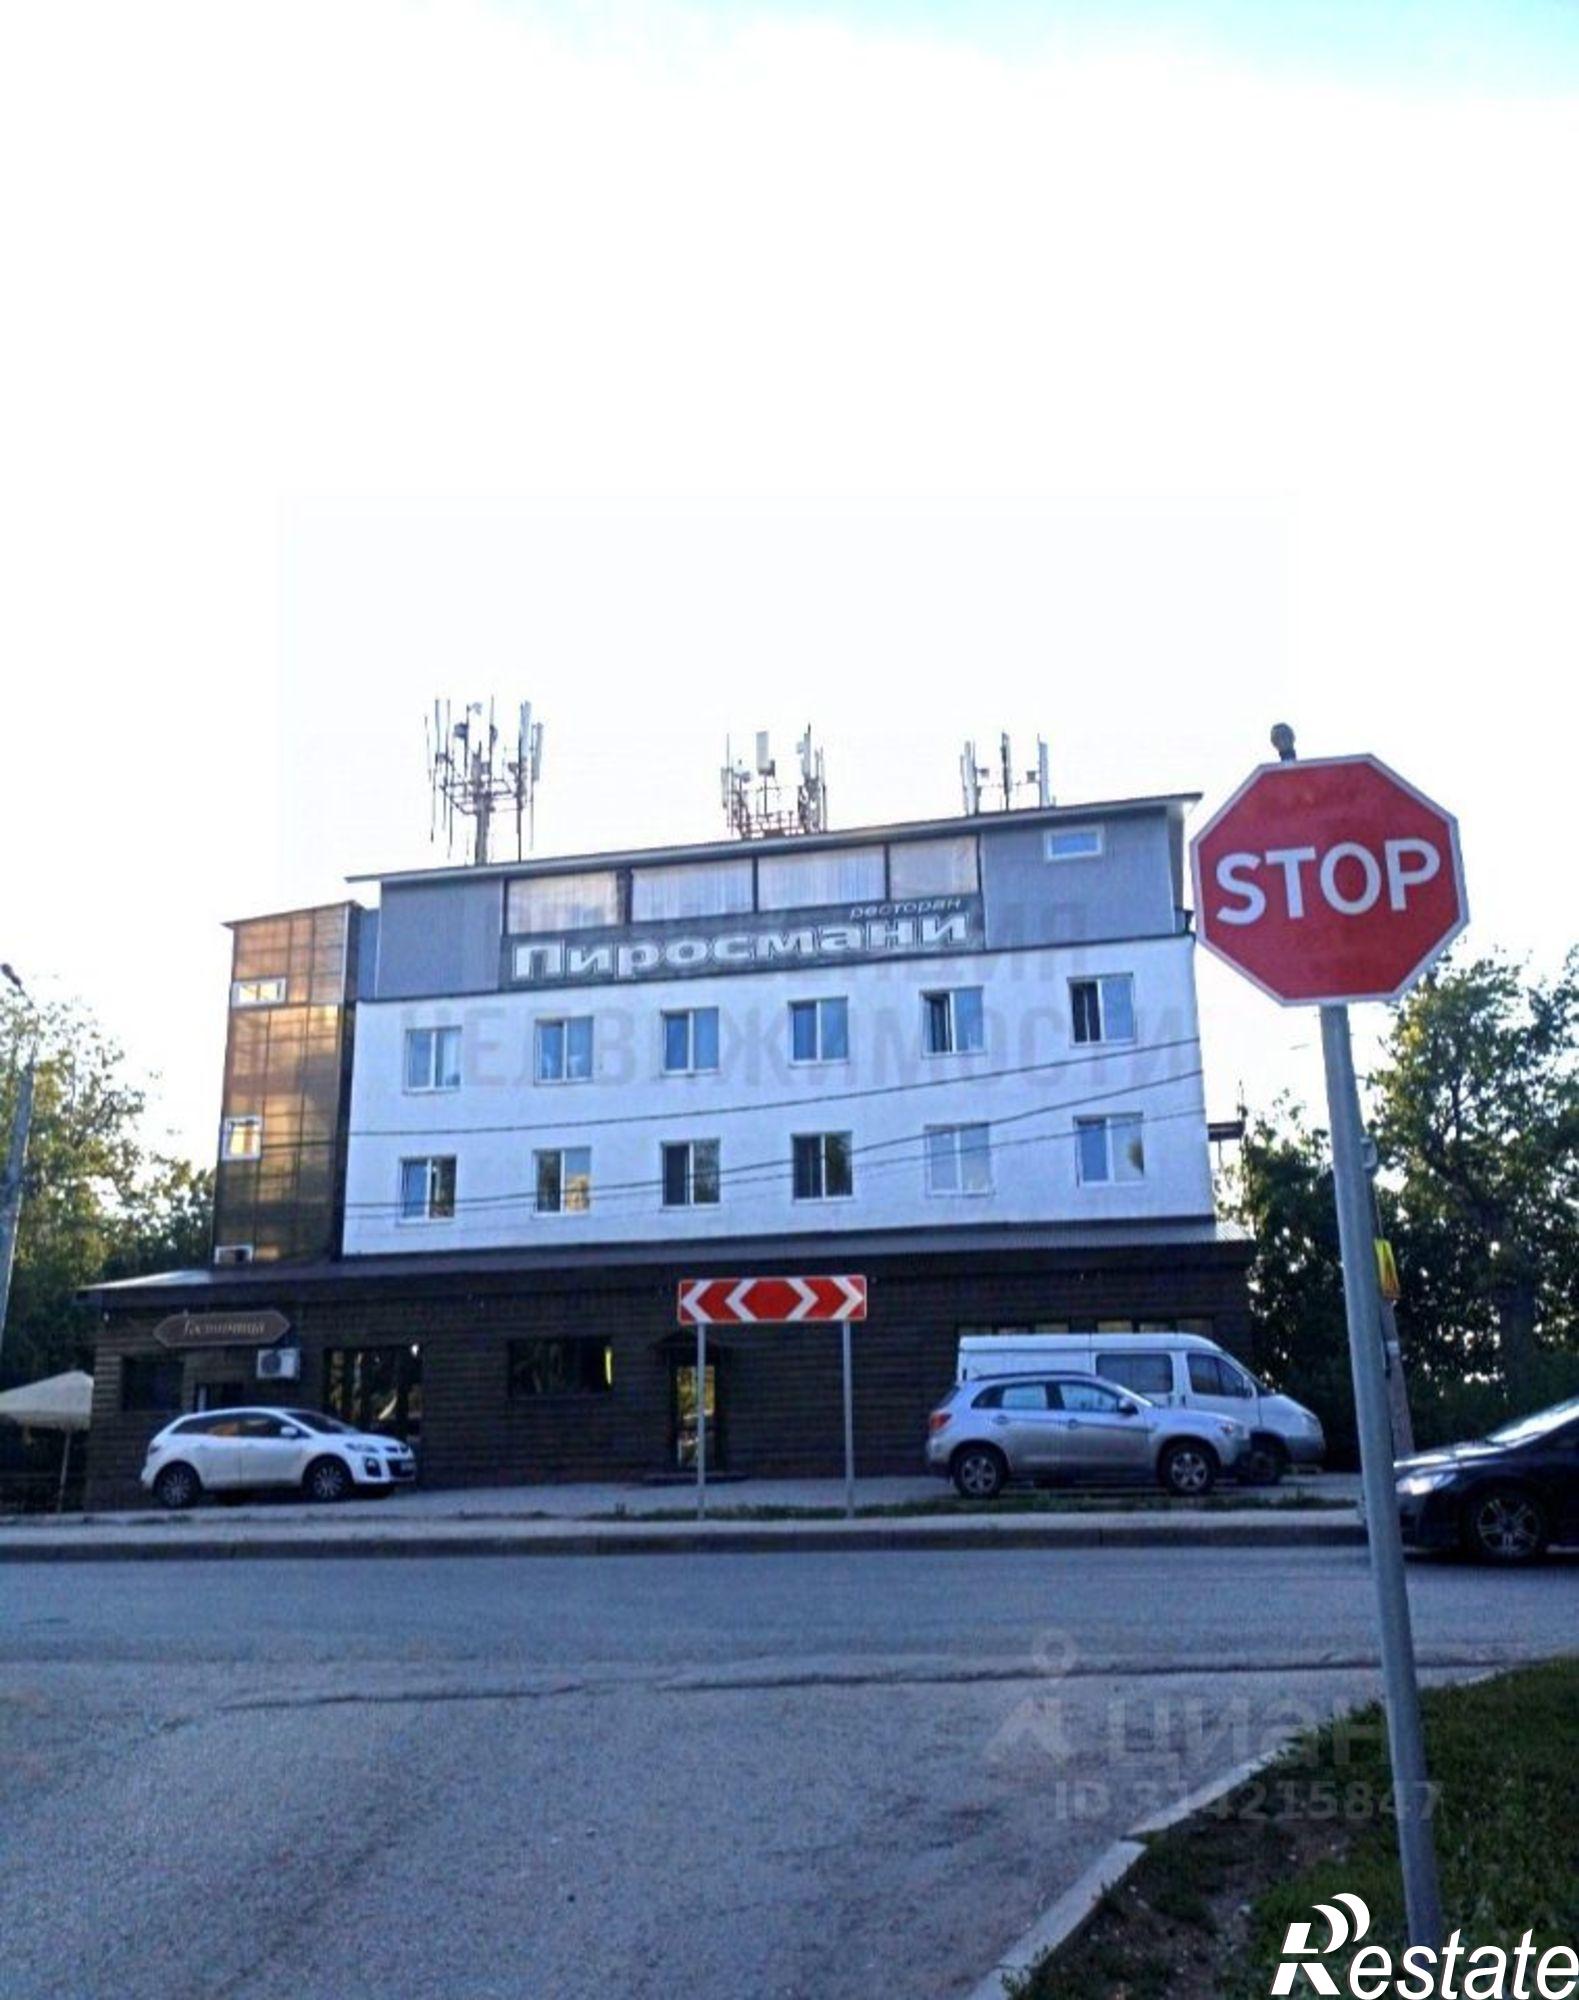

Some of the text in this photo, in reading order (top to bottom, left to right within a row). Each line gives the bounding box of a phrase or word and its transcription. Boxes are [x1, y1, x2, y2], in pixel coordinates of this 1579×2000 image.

[849, 898, 963, 920] ресторан
[1215, 837, 1441, 925] STOP
[510, 913, 969, 981] Пиросмани
